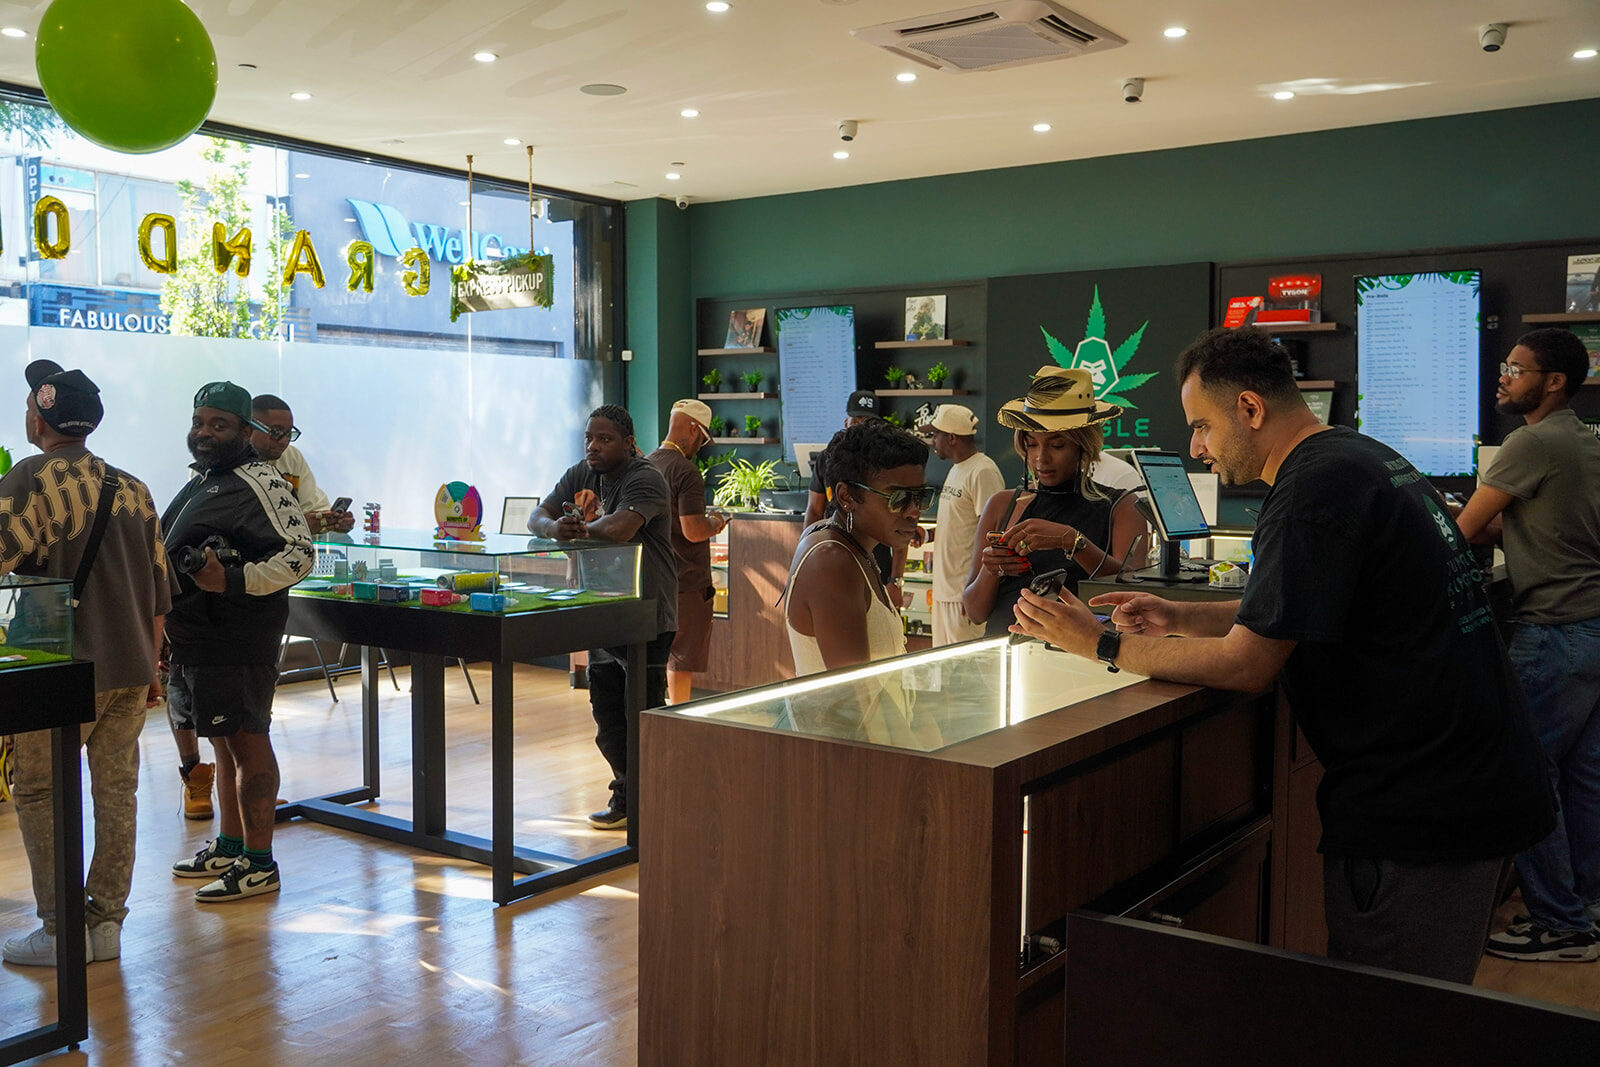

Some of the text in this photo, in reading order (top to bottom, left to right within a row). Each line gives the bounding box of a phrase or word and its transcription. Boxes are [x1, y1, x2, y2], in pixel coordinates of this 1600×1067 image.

[506, 272, 544, 293] PICKUP
[1281, 288, 1309, 297] TYSON
[59, 308, 168, 334] FABULOUS
